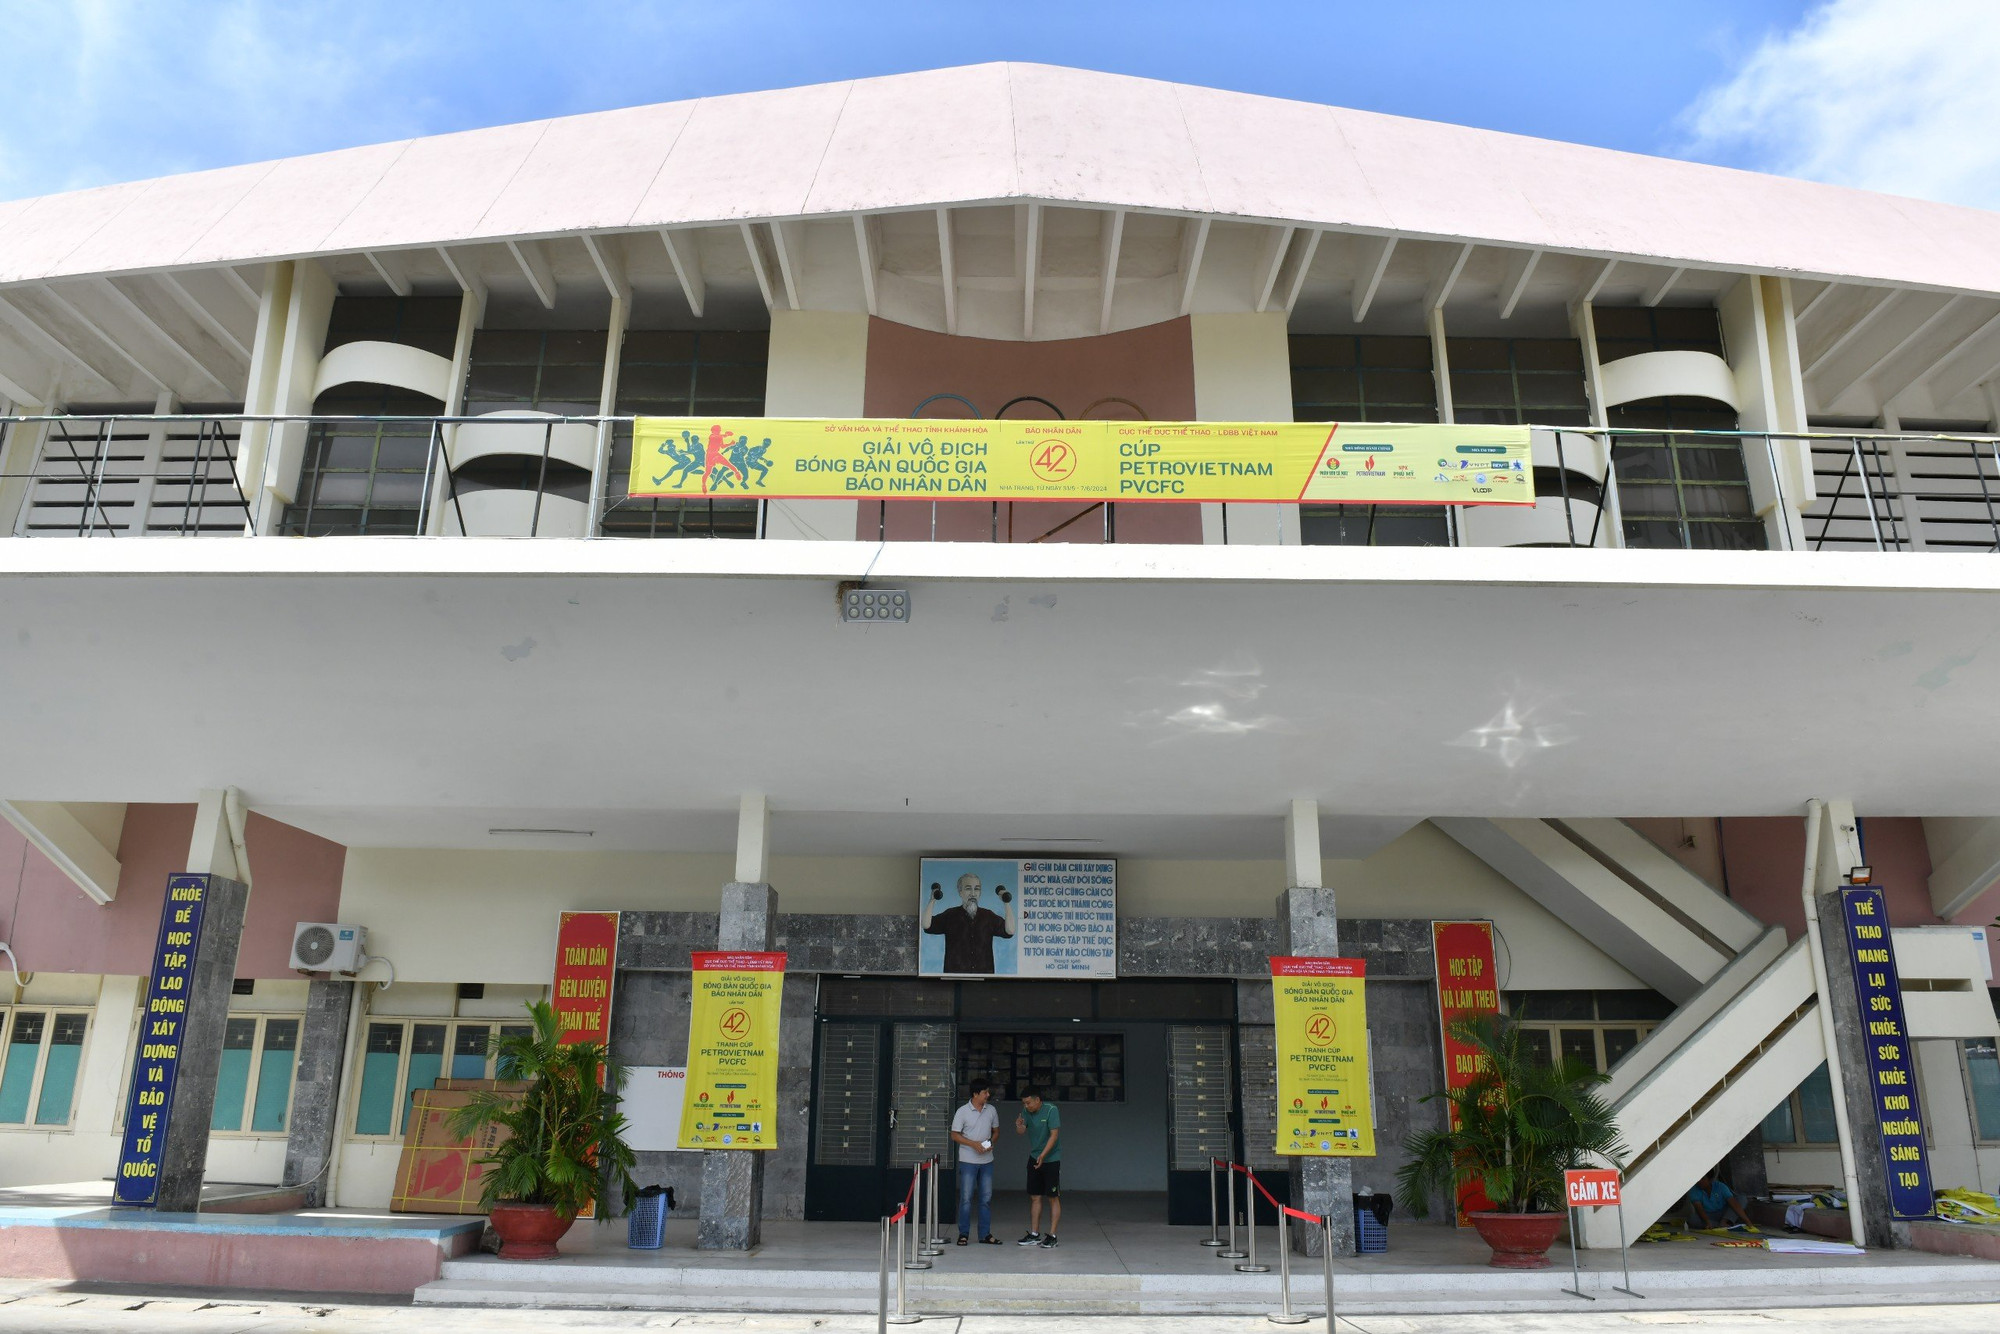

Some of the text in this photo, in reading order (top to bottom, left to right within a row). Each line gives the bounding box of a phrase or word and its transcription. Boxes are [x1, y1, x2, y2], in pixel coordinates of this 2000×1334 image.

[855, 425, 870, 433] HÓA
[872, 425, 882, 433] VÀ
[885, 424, 899, 433] THỂ
[1138, 427, 1152, 435] THỂ
[1173, 427, 1187, 435] THỂ
[1242, 428, 1258, 436] VIỆT
[863, 437, 987, 458] GIẢI VÔ ĐỊCH
[1120, 440, 1160, 456] CÚP
[796, 454, 987, 473] BÓNG BÀN QUỐC GIA
[1035, 445, 1067, 472] 42
[1120, 461, 1272, 476] PETROVIETNAM
[846, 474, 986, 491] BÁO NHÂN DÂN
[1120, 480, 1184, 494] PVCFC
[172, 884, 202, 901] KHỎE
[175, 905, 193, 922] ĐỂ
[1855, 897, 1875, 915] THỂ
[1106, 924, 1113, 933] AI
[1855, 926, 1882, 938] THAO
[167, 932, 192, 947] HỌC
[164, 951, 186, 970] TẬP,
[565, 944, 608, 965] TOÀN DÂN
[1857, 949, 1889, 963] MANG
[1449, 955, 1483, 980] HỌC TẬP
[160, 977, 182, 990] LAO
[560, 975, 607, 1002] RÈN LUYỆN
[740, 981, 759, 989] QUỐC
[1868, 973, 1886, 989] LẠI
[1321, 987, 1340, 995] QUỐC
[1443, 986, 1496, 1009] VÀ LÀM THEO
[151, 996, 184, 1015] ĐỘNG
[1870, 994, 1892, 1011] SỨC
[560, 1004, 602, 1030] THÂN THỂ
[723, 1012, 745, 1033] 42
[151, 1019, 176, 1036] XÂY
[1308, 1018, 1330, 1038] 42
[1870, 1017, 1901, 1036] KHỎE,
[143, 1044, 177, 1061] DỰNG
[1878, 1044, 1900, 1060] SỨC
[148, 1065, 163, 1082] VÀ
[658, 1070, 685, 1078] THÔNG
[1456, 1054, 1473, 1077] ĐẠO
[1879, 1066, 1907, 1085] KHỎE
[139, 1087, 164, 1105] BẢO
[1884, 1095, 1910, 1110] KHƠI
[142, 1113, 157, 1132] VỆ
[1882, 1116, 1920, 1135] NGUỒN
[137, 1133, 154, 1153] TỔ
[1890, 1144, 1920, 1161] SÁNG
[123, 1158, 156, 1178] QUỐC
[1570, 1176, 1617, 1200] CẤM XE
[1898, 1172, 1919, 1189] TẠO
